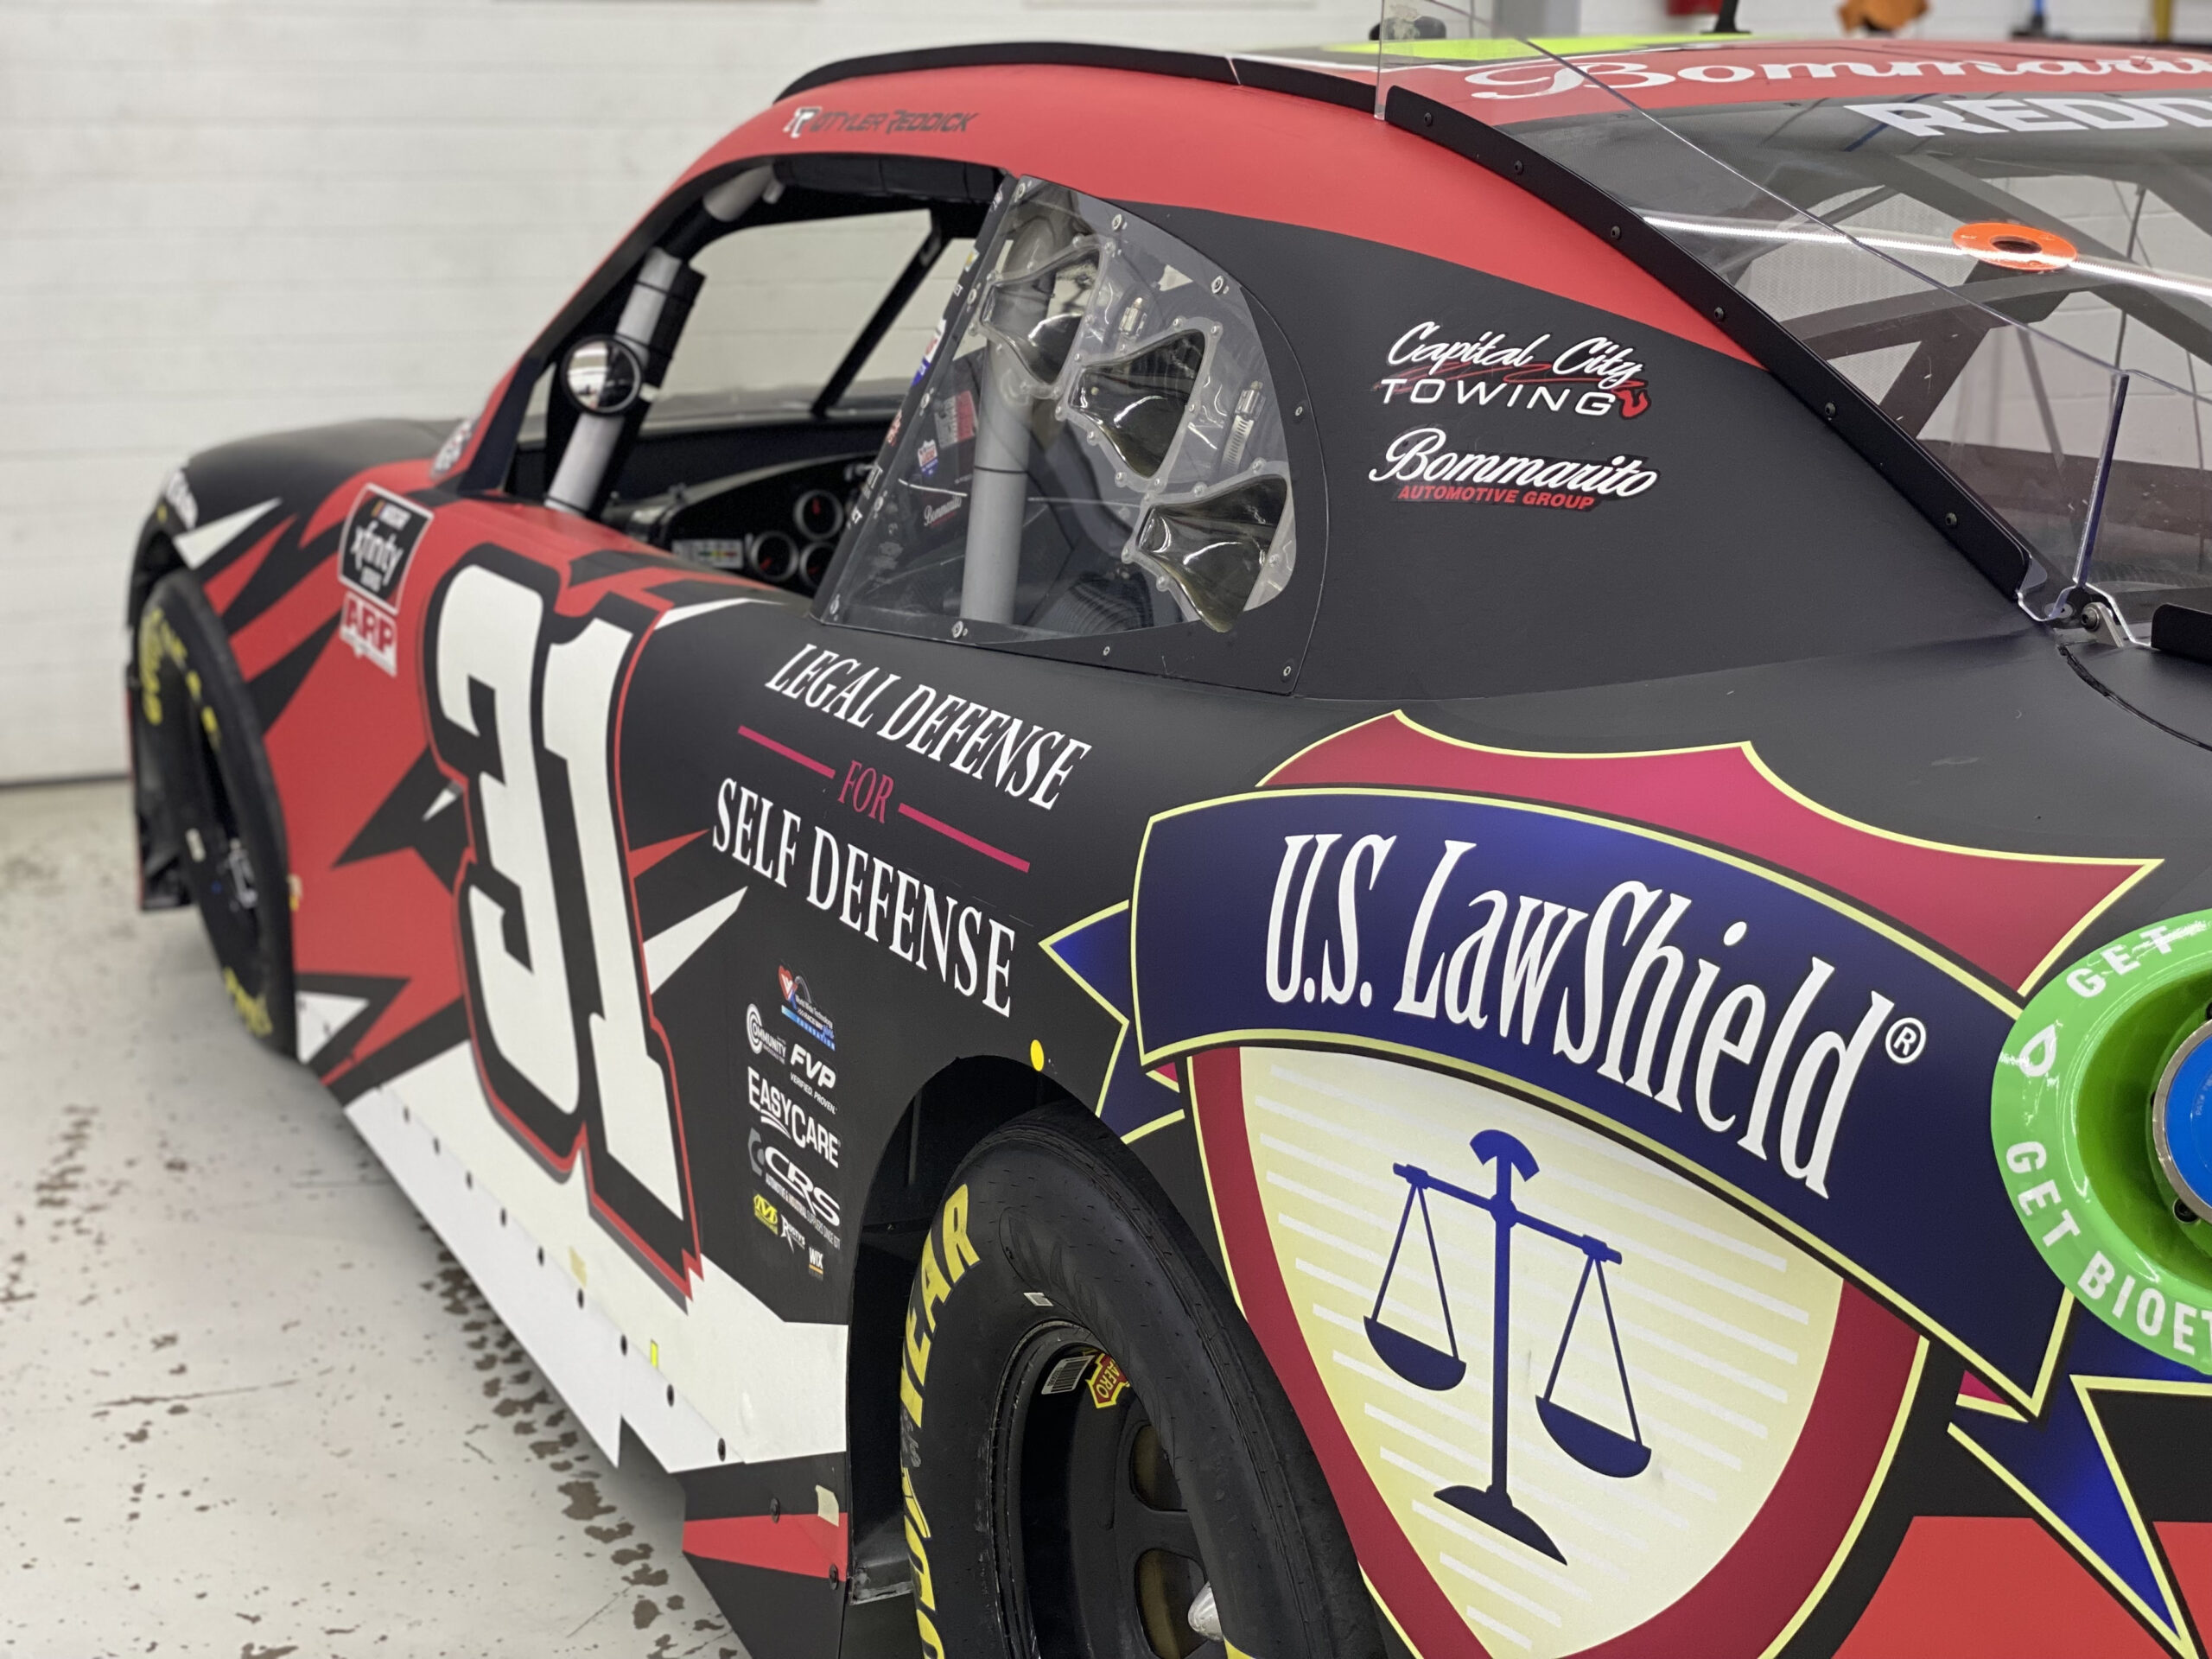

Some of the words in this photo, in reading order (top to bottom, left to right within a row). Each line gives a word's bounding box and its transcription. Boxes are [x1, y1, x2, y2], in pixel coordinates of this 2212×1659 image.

[1388, 321, 1550, 375] Capital
[1552, 337, 1644, 389] City
[1380, 378, 1616, 416] TOWING
[1368, 428, 1658, 498] Bommarito
[1398, 486, 1517, 505] AUTOMOTIVE
[1522, 491, 1595, 511] GROUP
[766, 644, 901, 728] LEGAL
[877, 684, 1091, 810] DEFENSE
[838, 760, 894, 823] FOR
[437, 564, 683, 1221] 31
[713, 778, 801, 887] SELF
[806, 826, 1015, 1017] DEFENSE
[1265, 832, 1396, 1007] U.S.
[2066, 925, 2172, 998] GET
[790, 1044, 836, 1090] FVP
[748, 1066, 839, 1169] EASYCARE
[2006, 1141, 2081, 1248] GET
[809, 1246, 823, 1269] WIX
